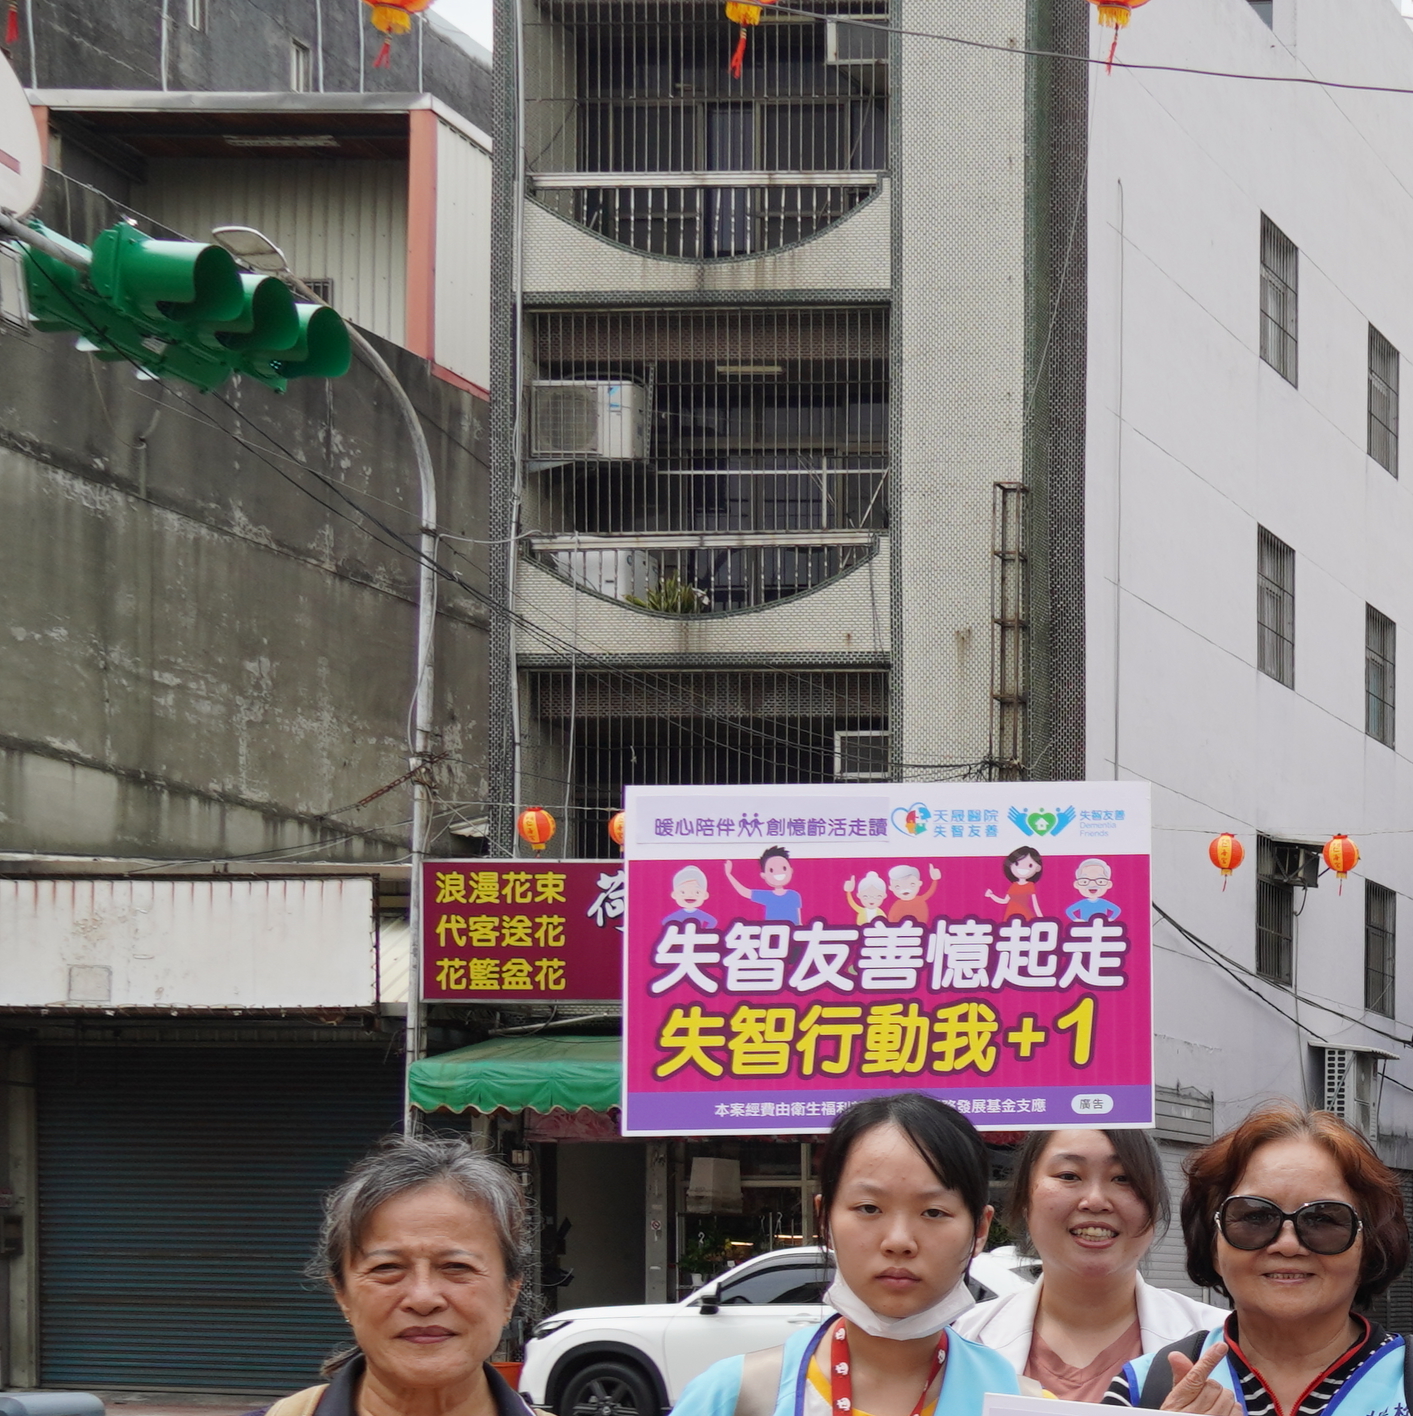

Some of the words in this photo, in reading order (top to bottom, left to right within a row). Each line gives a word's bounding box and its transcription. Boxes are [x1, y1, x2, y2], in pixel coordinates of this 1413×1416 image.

[767, 815, 888, 838] 創憶齡活走讀
[933, 808, 999, 824] 天晟醫院
[1079, 810, 1126, 821] 失智友善
[933, 825, 999, 838] 失智友善
[435, 871, 566, 903] 浪漫花束
[435, 915, 566, 947] 代客送花
[651, 919, 1126, 993] 失智友善憶起走
[436, 958, 566, 991] 花籃盆花
[656, 997, 1096, 1078] 失智行動我+1
[1080, 1098, 1104, 1111] 廣告
